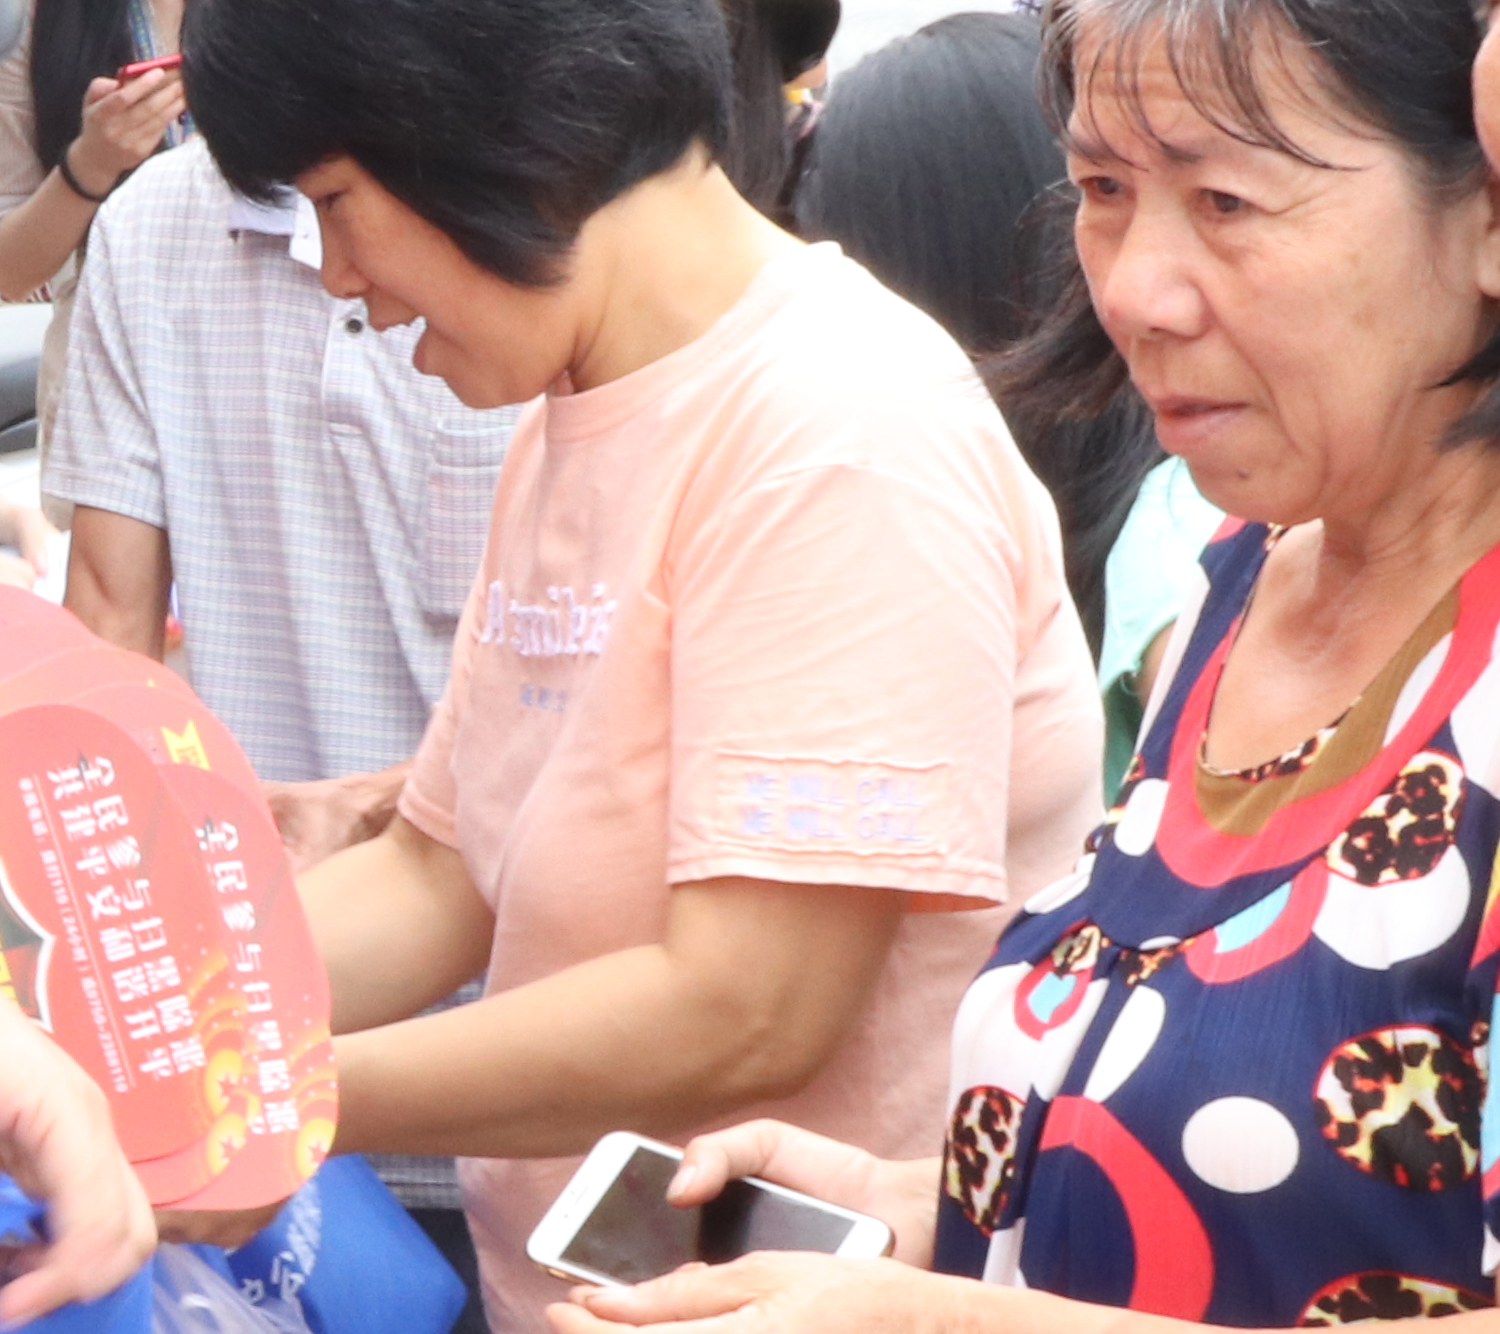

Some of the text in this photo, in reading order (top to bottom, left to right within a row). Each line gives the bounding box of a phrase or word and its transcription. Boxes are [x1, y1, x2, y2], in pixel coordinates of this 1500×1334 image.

[47, 765, 175, 1082] 共建平安和谐开平
[80, 756, 206, 1074] 全民参与扫黑除恶
[206, 820, 300, 1134] 全民参与扫黑除恶
